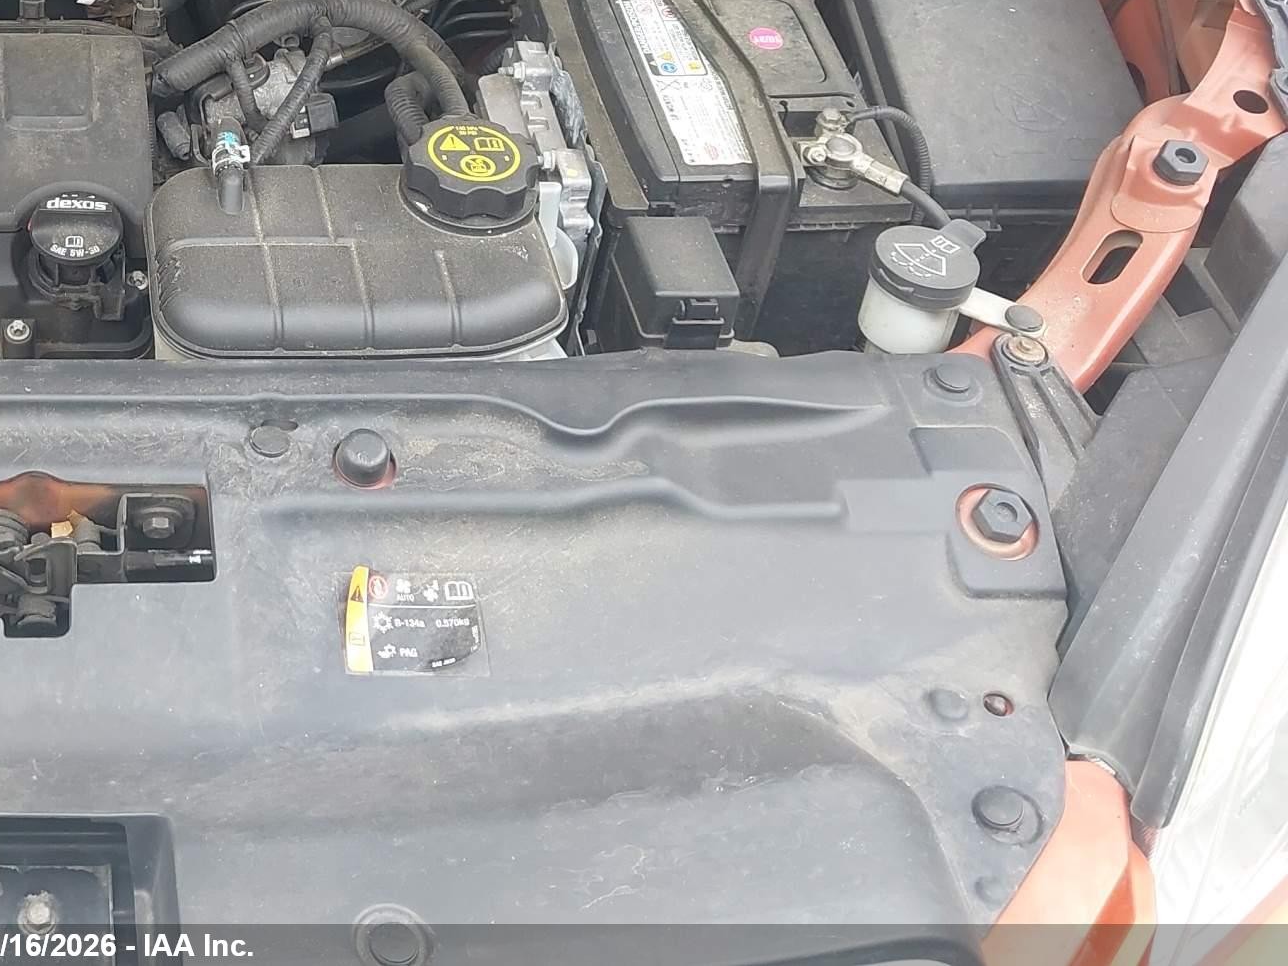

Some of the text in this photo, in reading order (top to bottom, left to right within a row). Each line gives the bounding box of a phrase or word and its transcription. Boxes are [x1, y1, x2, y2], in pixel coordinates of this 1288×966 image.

[46, 197, 109, 211] dexos
[50, 244, 67, 256] SAE
[396, 593, 414, 602] AUTO
[394, 619, 425, 628] R-134a
